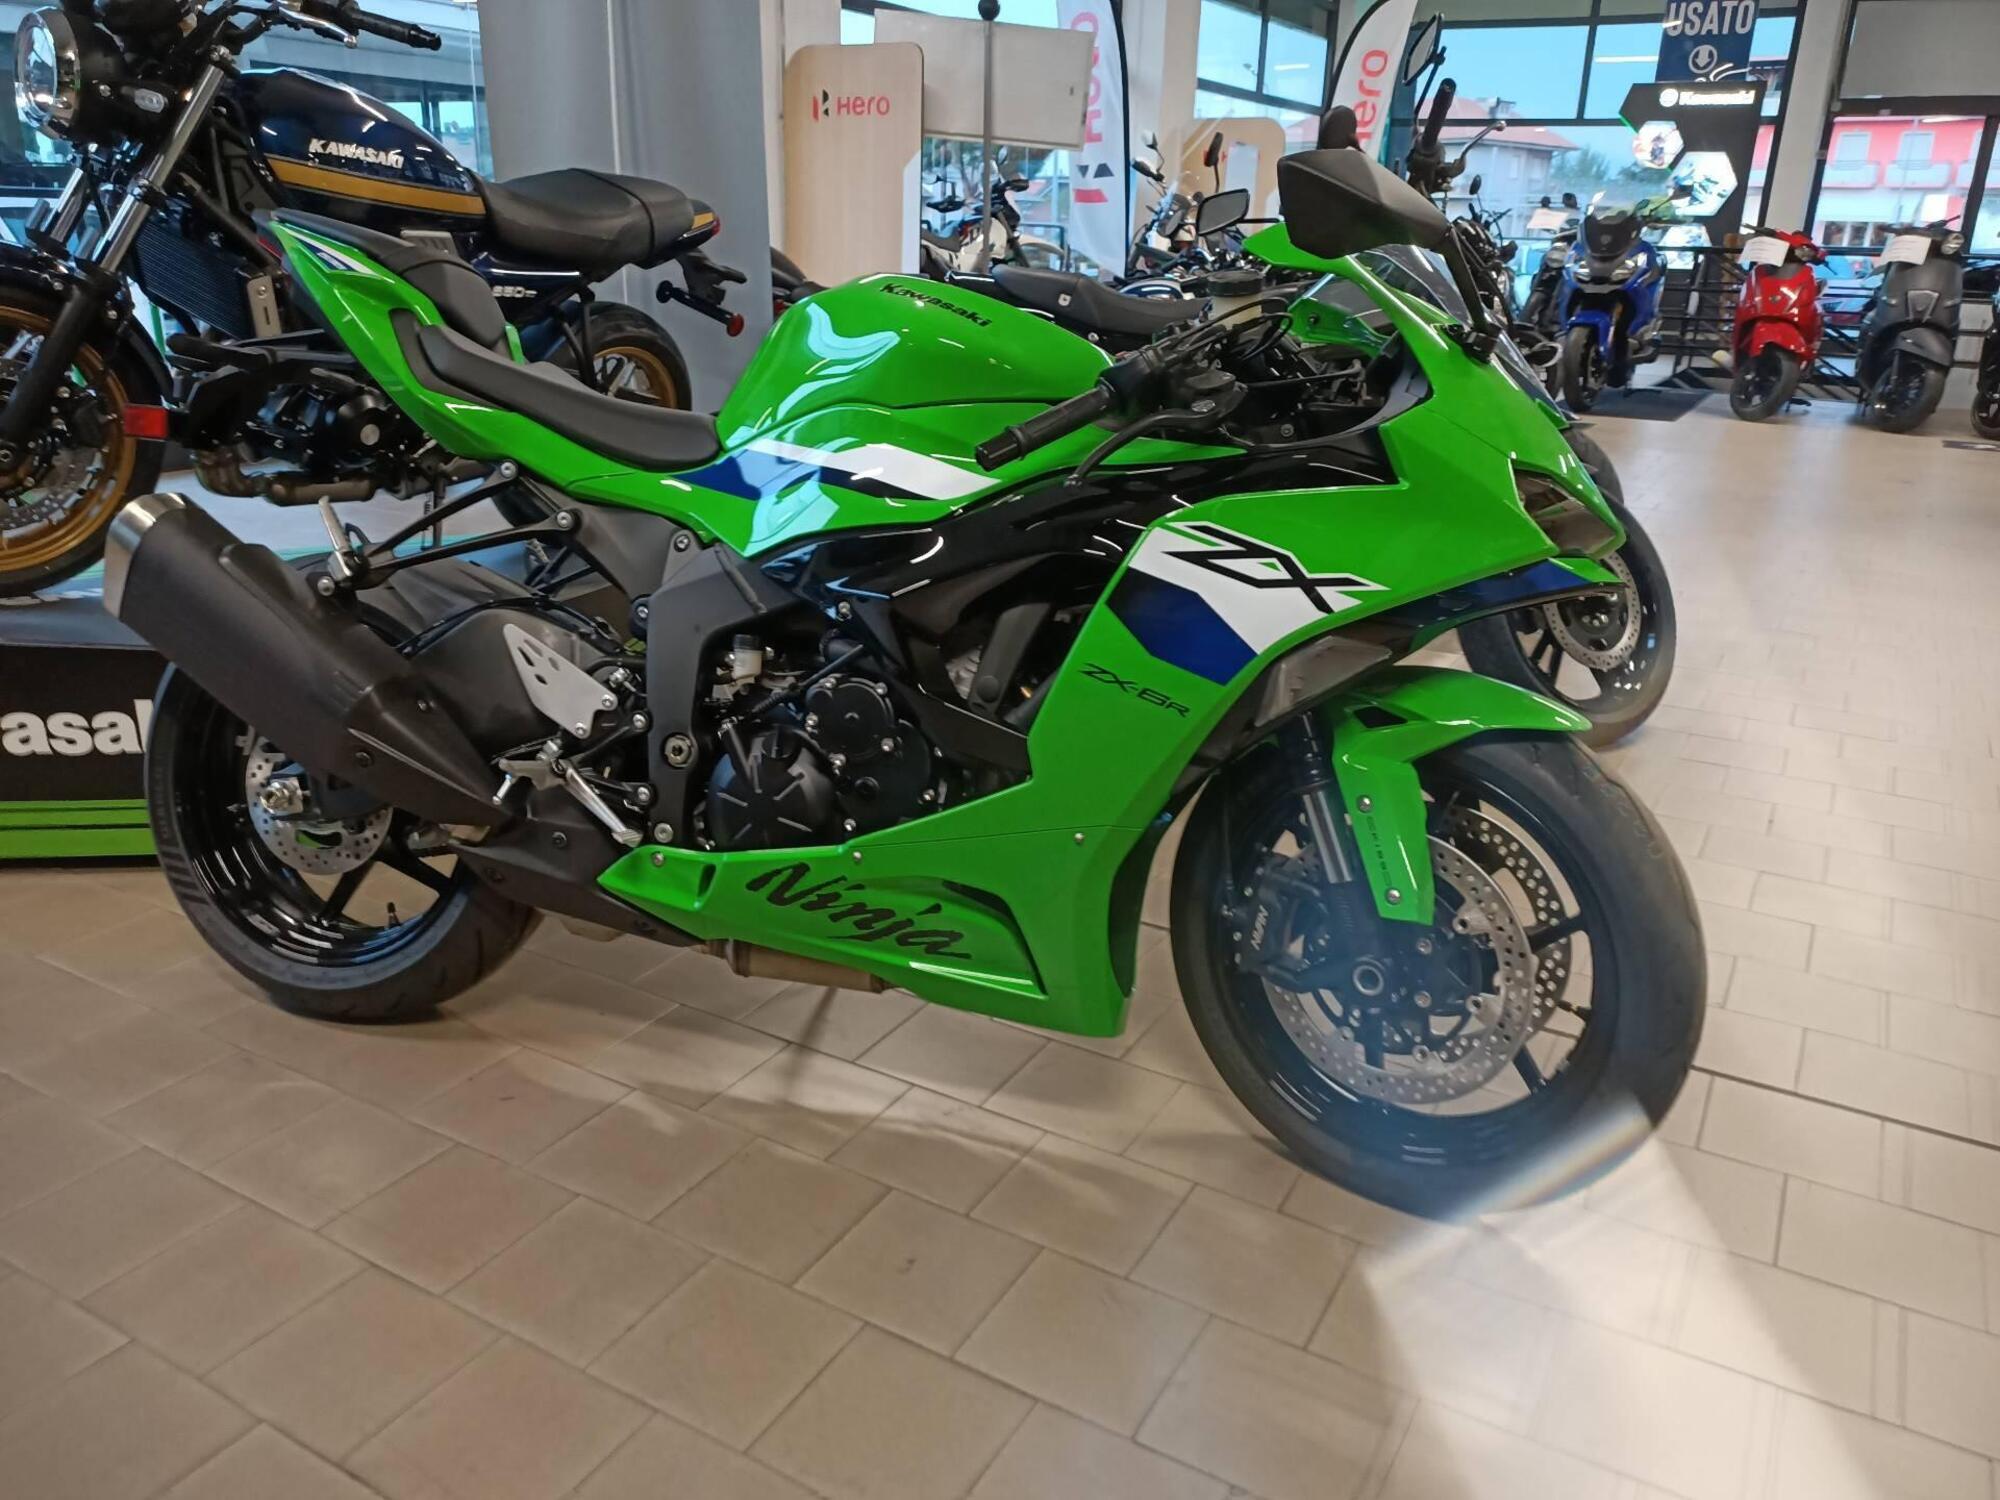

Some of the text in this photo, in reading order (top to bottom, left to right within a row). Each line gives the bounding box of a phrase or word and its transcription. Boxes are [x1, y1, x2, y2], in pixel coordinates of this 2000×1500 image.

[1666, 0, 1755, 36] USATO
[836, 96, 890, 116] Hero
[1354, 49, 1388, 140] ero
[308, 138, 405, 169] KAWASAKI
[880, 283, 993, 327] Kawasaki
[1078, 662, 1190, 718] ZX-6R
[745, 862, 972, 959] Ninja
